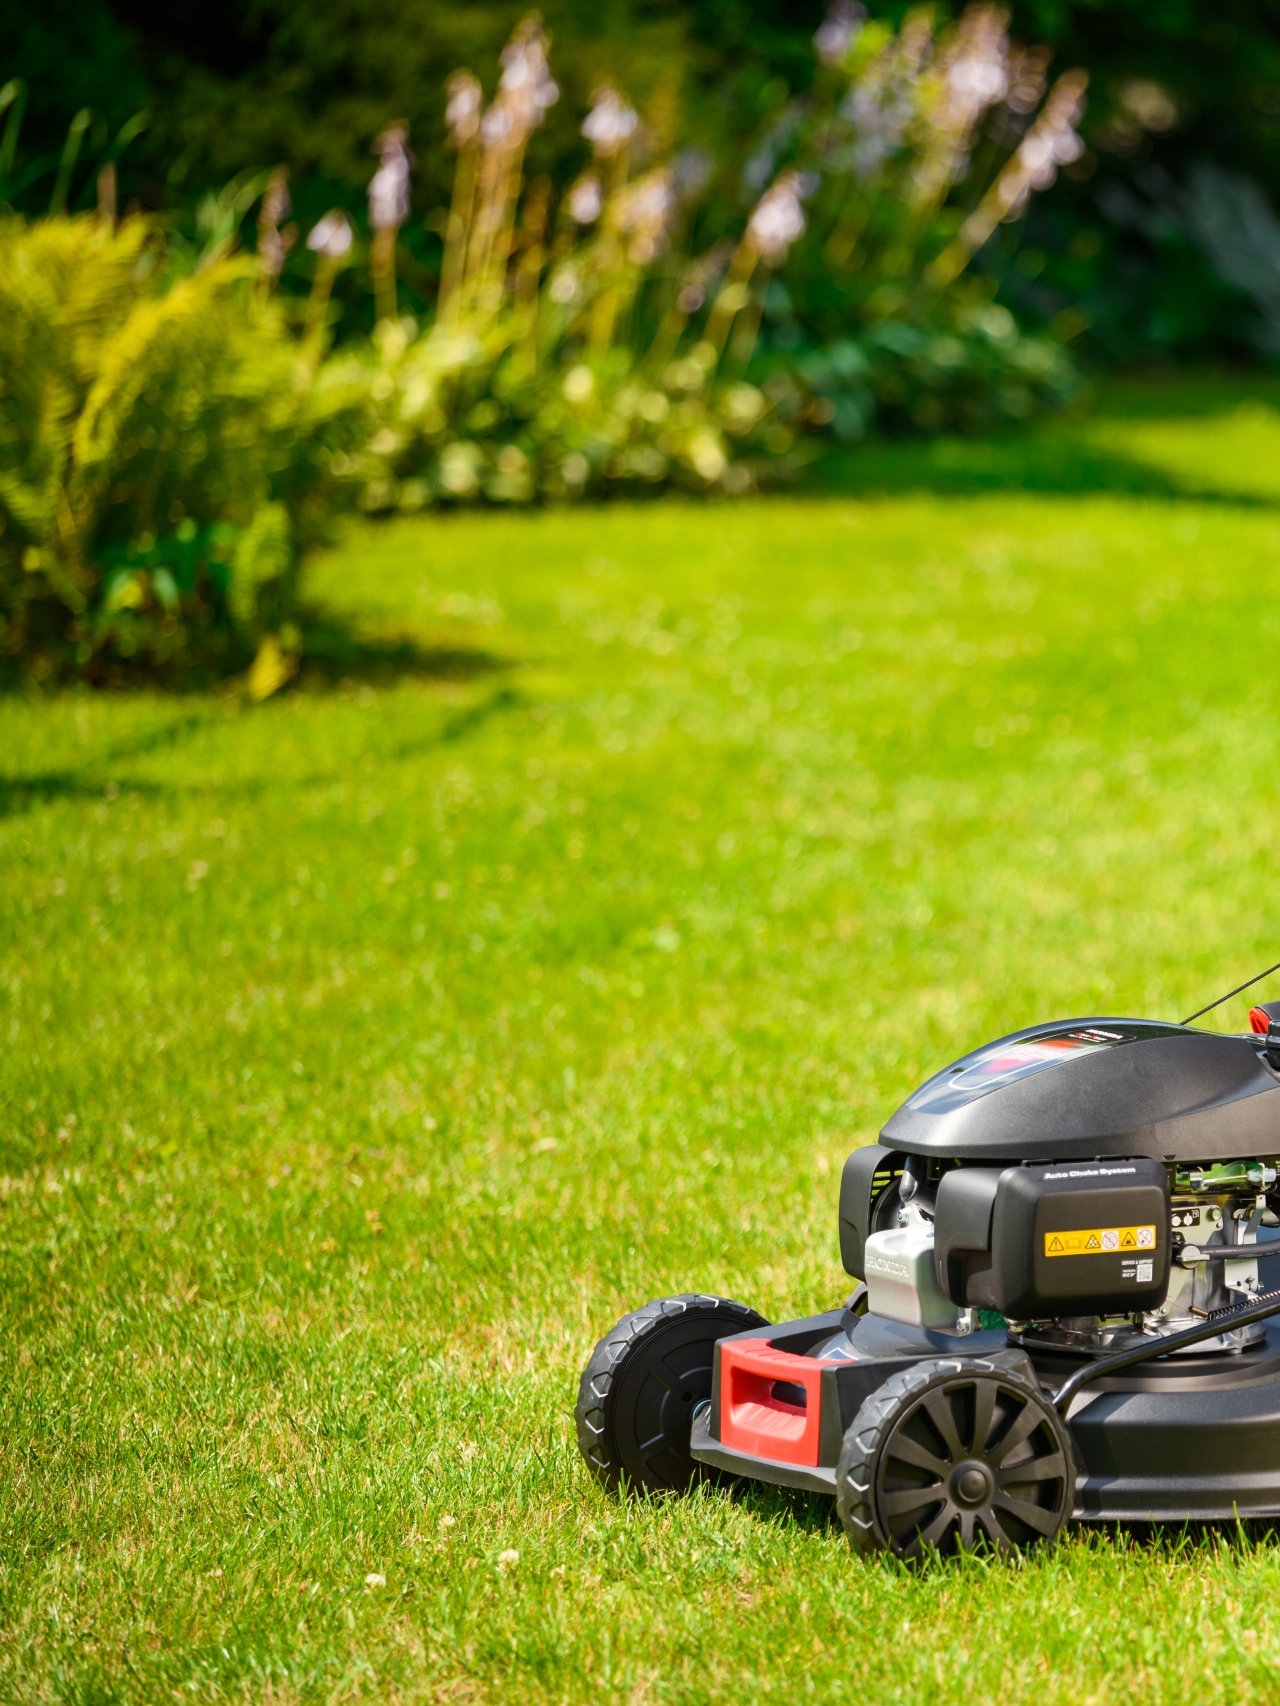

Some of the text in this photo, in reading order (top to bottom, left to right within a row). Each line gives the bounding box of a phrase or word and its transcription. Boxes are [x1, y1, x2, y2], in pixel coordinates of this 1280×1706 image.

[1043, 1167, 1137, 1180] Auto Choke System
